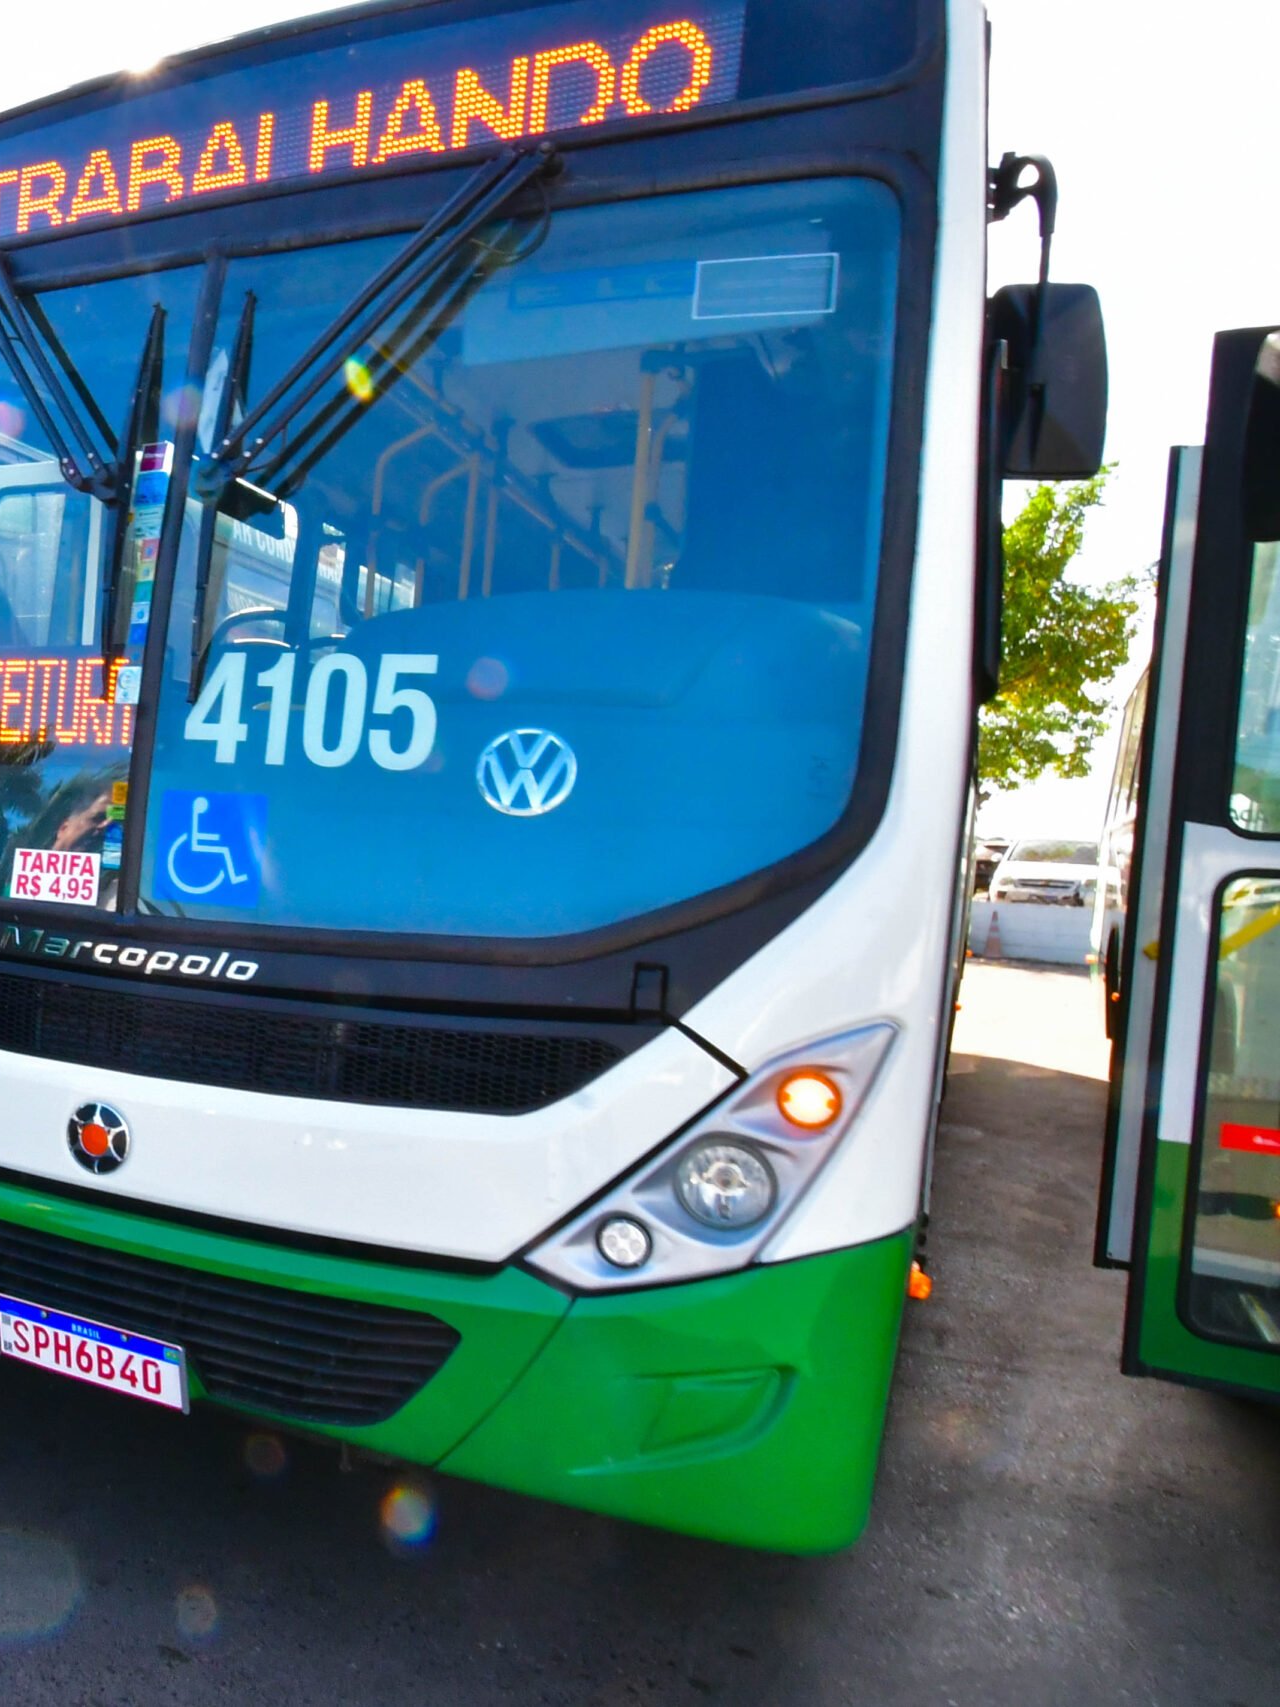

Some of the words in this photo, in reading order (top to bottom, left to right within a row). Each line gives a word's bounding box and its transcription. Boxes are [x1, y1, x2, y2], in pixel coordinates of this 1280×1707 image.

[184, 652, 439, 771] 4105
[18, 851, 95, 878] TARIFA
[15, 874, 42, 897] R$
[48, 876, 94, 901] 4,95
[0, 925, 260, 982] Marcopolo
[71, 1322, 101, 1340] BRASIL
[13, 1320, 162, 1395] SPH6B40
